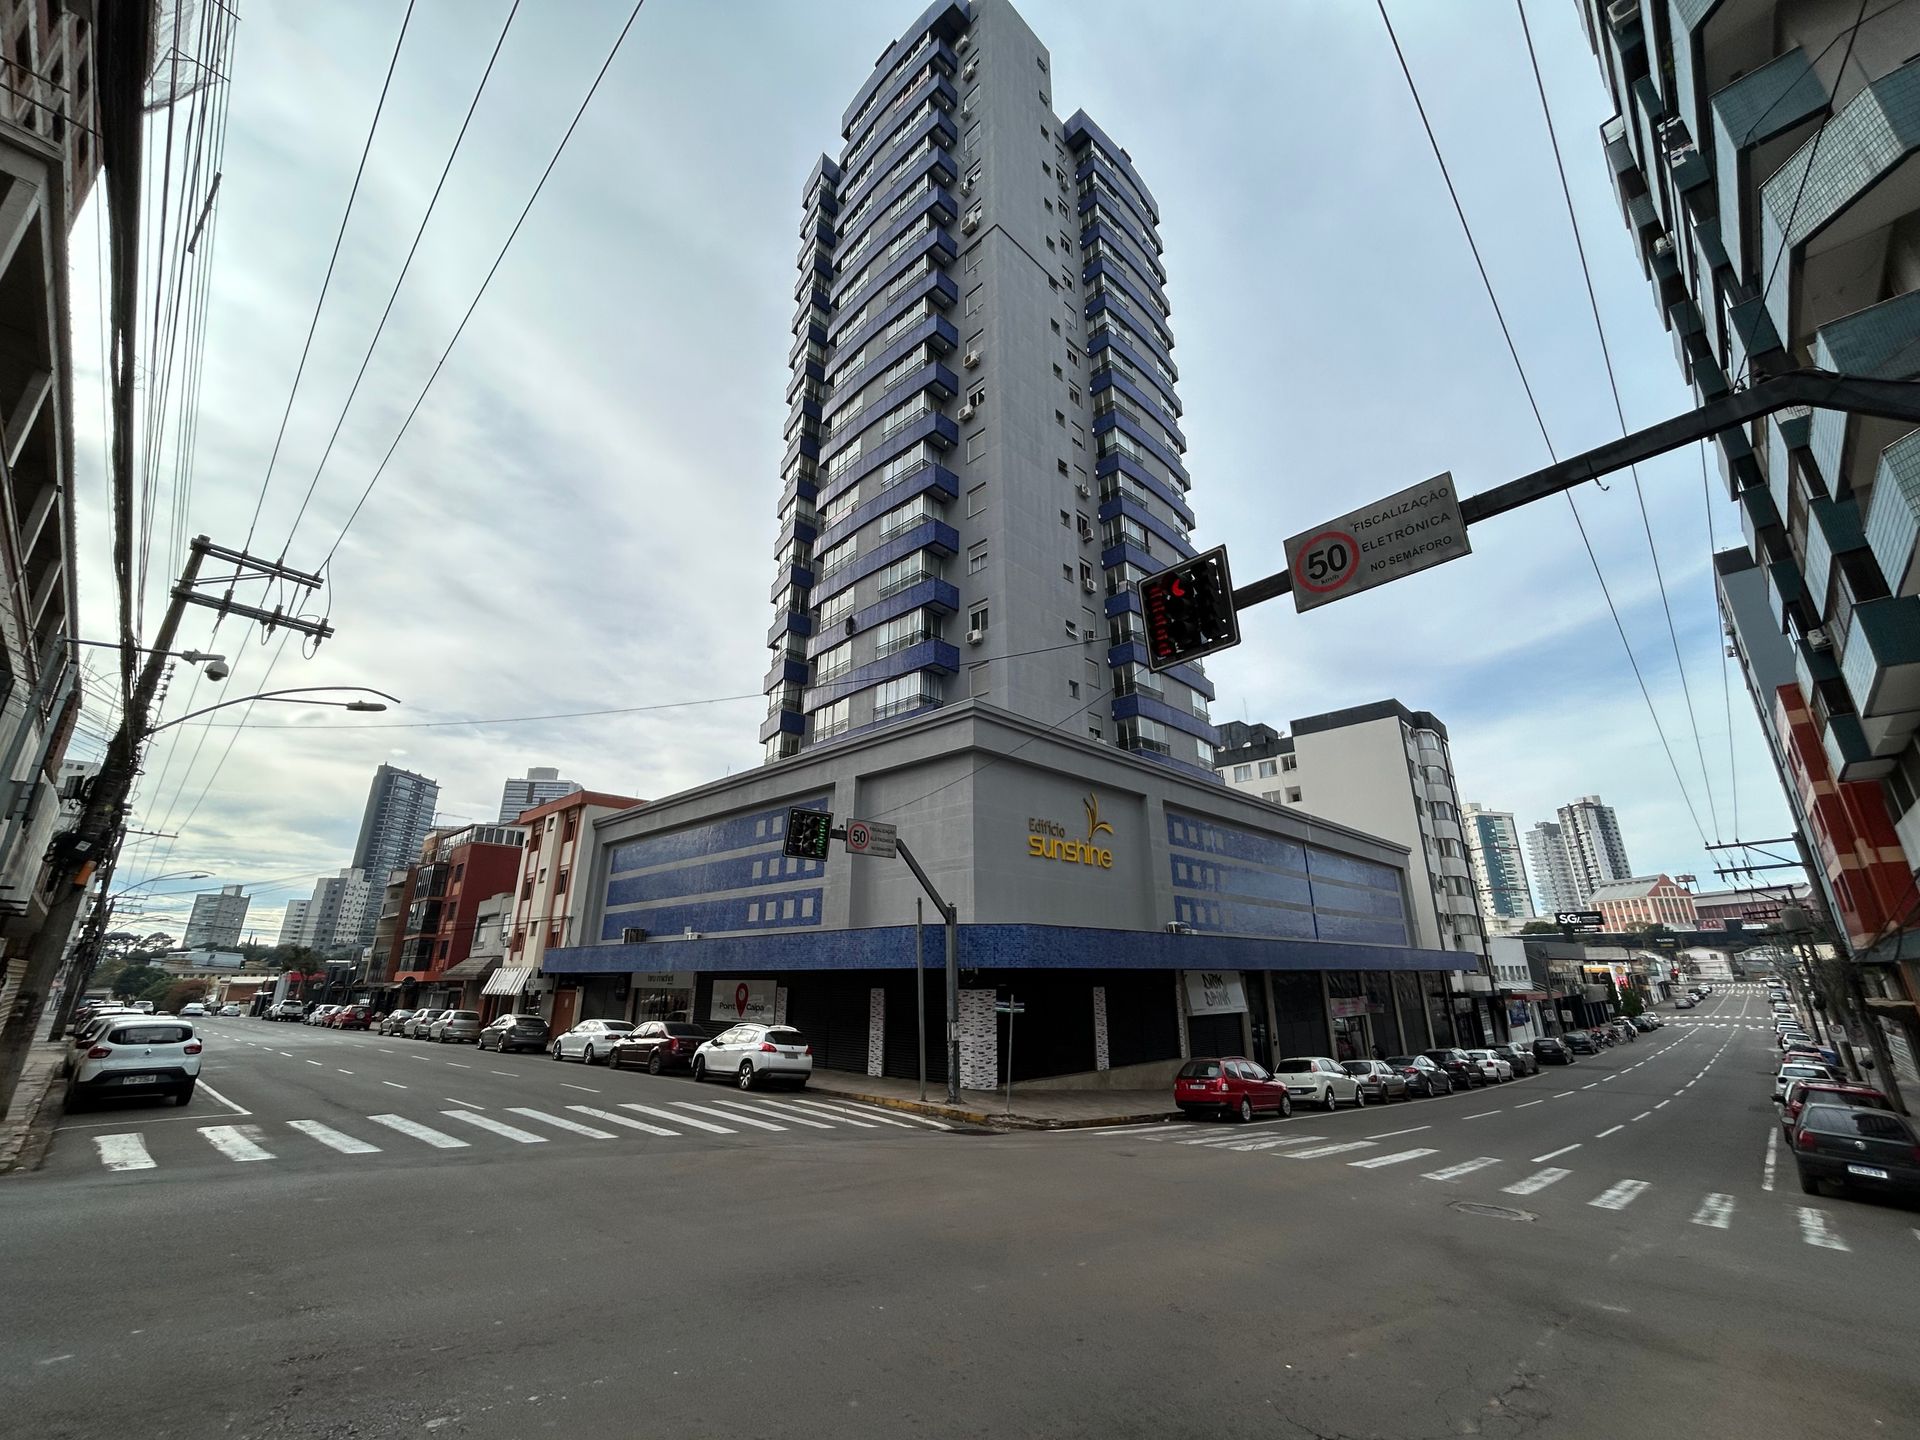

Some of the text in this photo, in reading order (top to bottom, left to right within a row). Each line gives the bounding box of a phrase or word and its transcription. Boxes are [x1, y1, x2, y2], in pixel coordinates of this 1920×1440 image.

[1352, 487, 1449, 533] FISCALIZAÇÃO
[1361, 512, 1451, 553] ELETRÔNICA
[1308, 543, 1347, 580] 50
[1370, 535, 1452, 572] NO SEMÁFORO
[853, 829, 866, 843] 50
